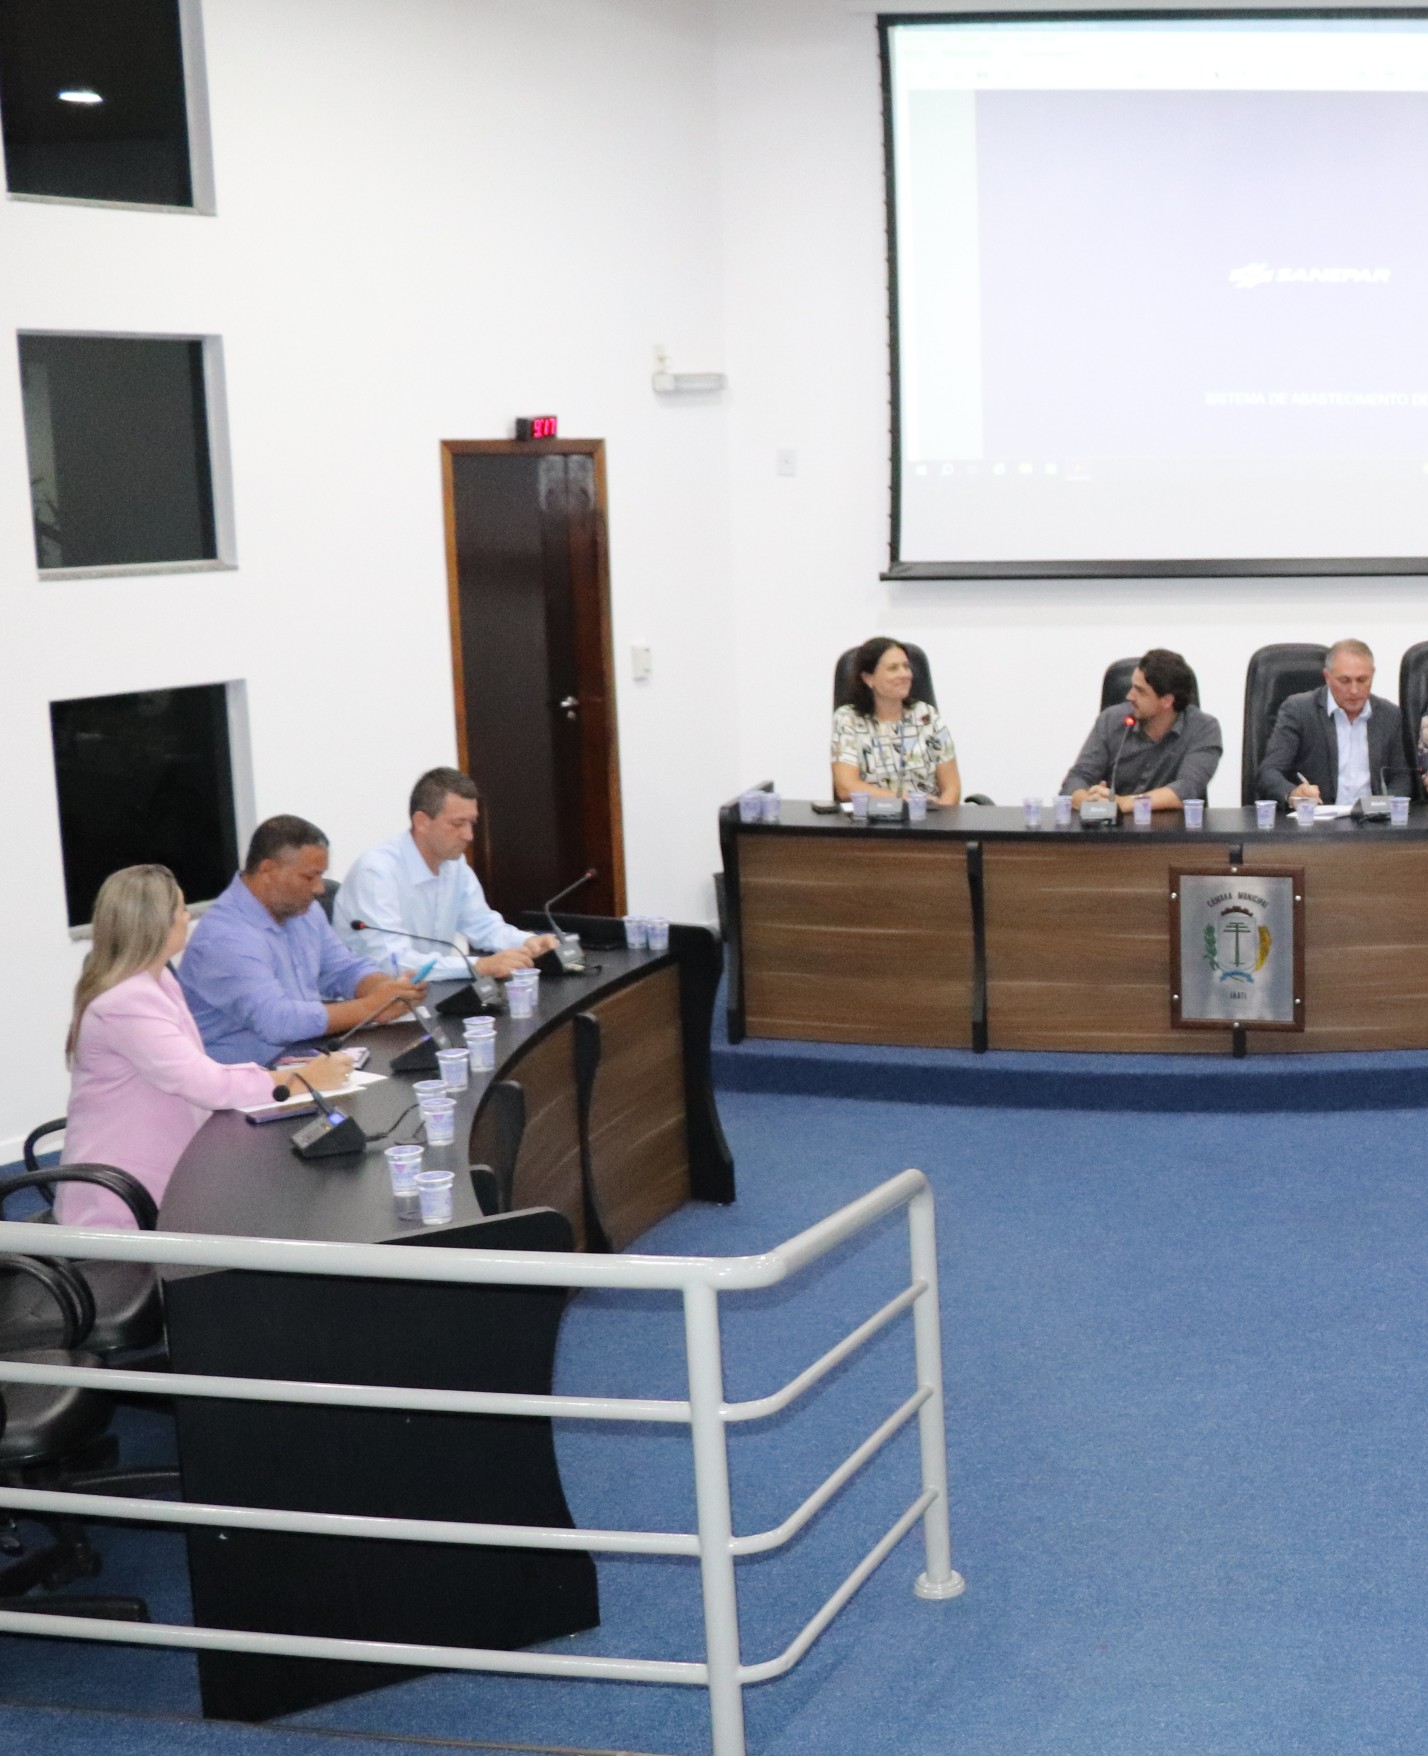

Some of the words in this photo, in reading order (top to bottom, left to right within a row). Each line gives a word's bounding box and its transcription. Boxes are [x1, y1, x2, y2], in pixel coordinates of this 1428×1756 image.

[1275, 267, 1392, 284] SANEPAR
[1268, 391, 1288, 406] DE
[1291, 391, 1409, 407] ABASTECIMENTO
[1238, 892, 1269, 908] MUNICIPAL
